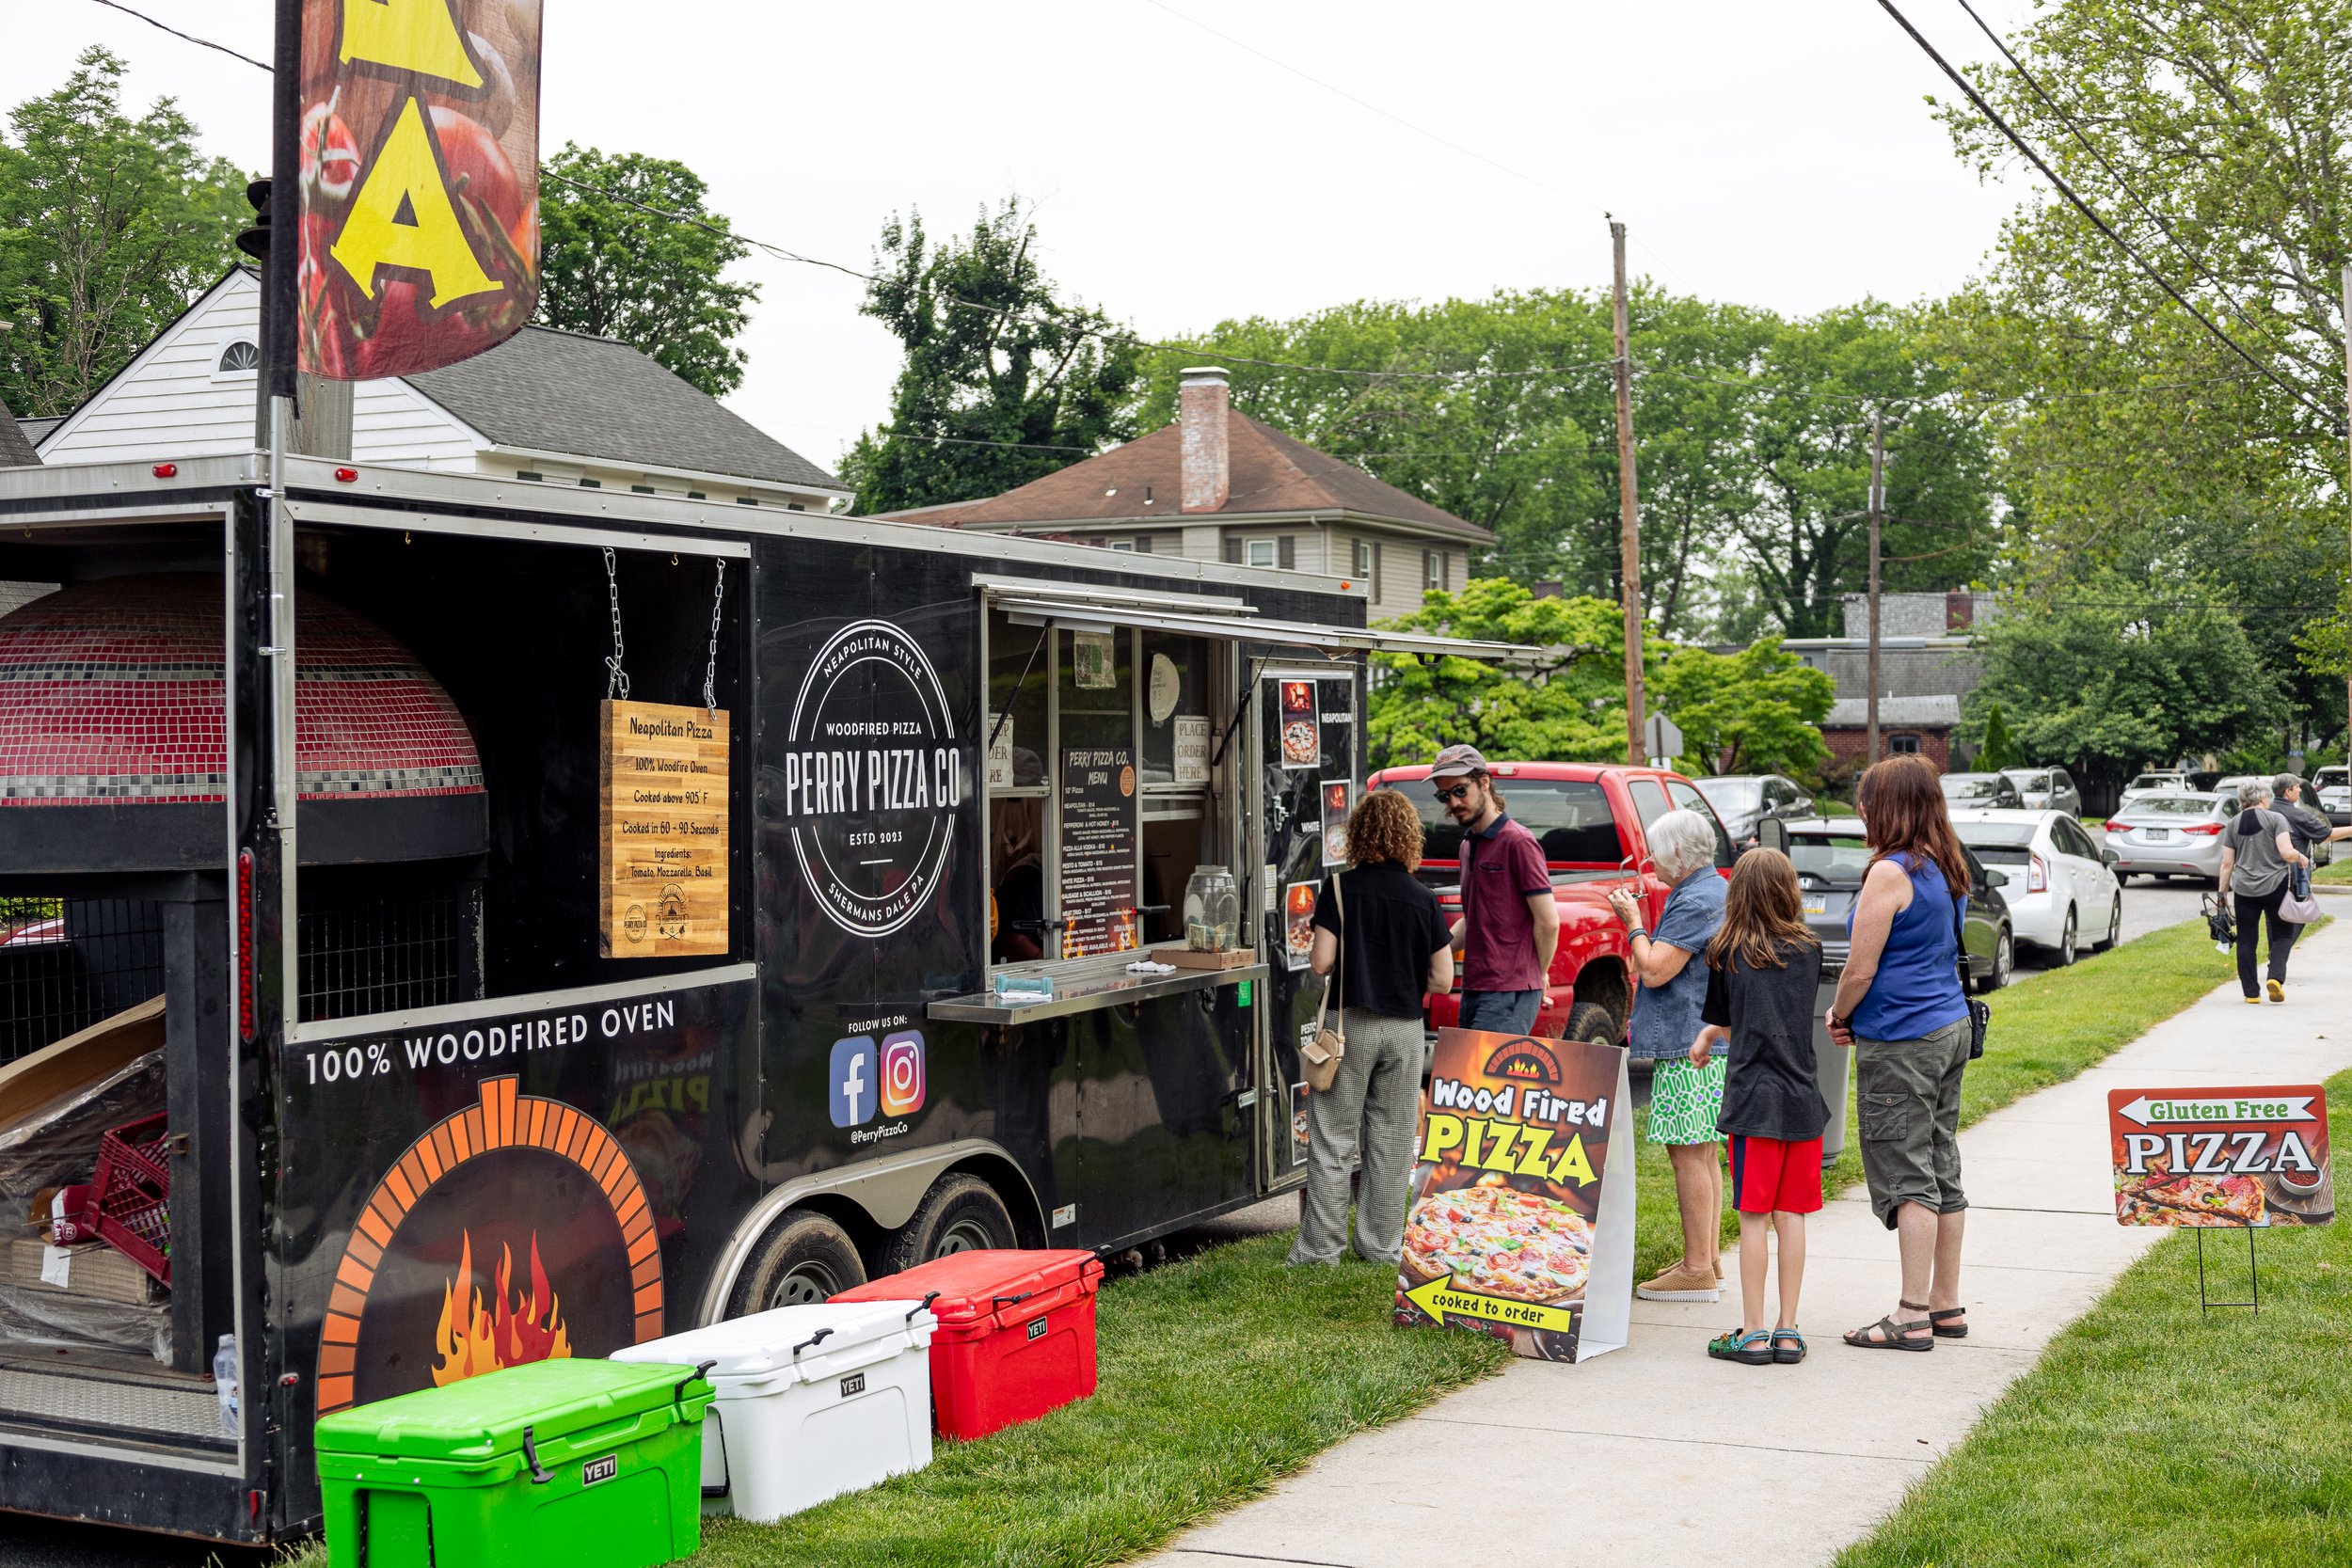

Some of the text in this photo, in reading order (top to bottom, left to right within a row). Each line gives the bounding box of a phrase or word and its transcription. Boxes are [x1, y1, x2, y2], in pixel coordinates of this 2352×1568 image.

[824, 637, 922, 680] NEAPOLITAN STYLE
[1321, 712, 1353, 723] NEAPOLITAN
[630, 717, 712, 740] Neapolitan Pizza
[826, 721, 922, 736] WOODFIRED PIZZA
[1179, 723, 1206, 736] PLACE
[1069, 751, 1129, 768] PERRY PIZZA CO.
[1178, 745, 1206, 757] ORDER
[635, 757, 707, 773] 100% Woodfire Oven
[1179, 767, 1202, 779] HERE
[787, 747, 961, 816] PERRY PIZZA CO
[1088, 771, 1107, 785] MENU
[634, 790, 660, 803] Cooked
[662, 792, 683, 803] above
[623, 821, 649, 833] Cooked
[652, 822, 658, 833] in
[660, 821, 670, 834] 60
[678, 821, 689, 834] 90
[691, 822, 719, 835] Seconds
[1301, 821, 1320, 832] WHITE
[850, 832, 902, 846] ESTD 2023
[655, 847, 691, 862] Ingredients:
[630, 865, 656, 878] Tomato,
[695, 865, 712, 878] Basil
[828, 875, 924, 922] SHERMANS DALE PA
[849, 1014, 908, 1034] FOLLOW US ON:
[306, 1000, 675, 1085] 100% WOODFIRED OVEN
[1434, 1079, 1607, 1127] Wood Fired
[2150, 1101, 2289, 1120] Gluten Free
[850, 1121, 908, 1144] @PerryPizzaCo
[1420, 1114, 1598, 1187] PIZZA
[2122, 1130, 2319, 1176] PIZZA
[1432, 1294, 1545, 1323] cooked to order
[1028, 1320, 1045, 1338] YETI
[842, 1377, 863, 1394] YETI
[585, 1459, 613, 1481] YETI
